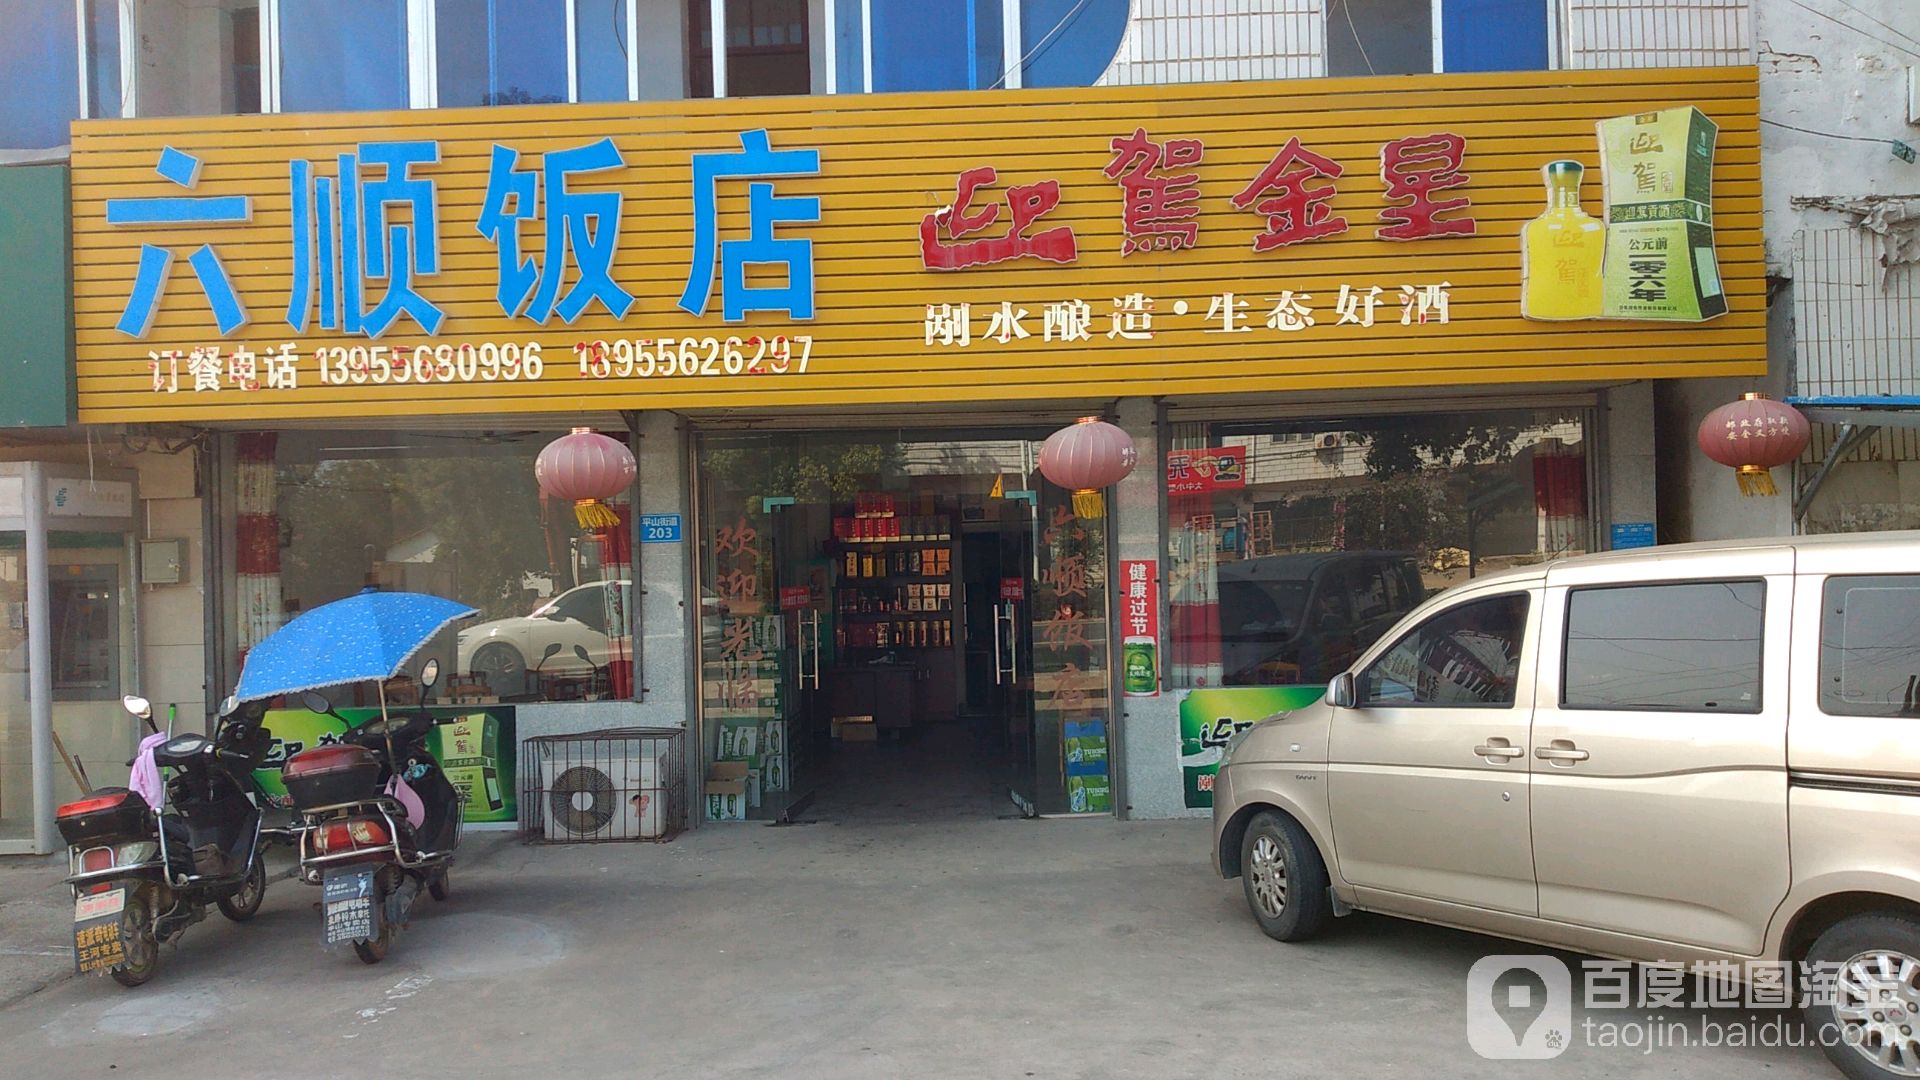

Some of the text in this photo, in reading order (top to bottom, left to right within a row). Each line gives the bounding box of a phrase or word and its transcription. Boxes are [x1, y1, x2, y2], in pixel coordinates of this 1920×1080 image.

[105, 128, 822, 339] 六顺饭店
[1628, 237, 1668, 251] 公元前
[1628, 253, 1667, 302] 一零六年
[148, 335, 813, 393] 订餐电话 13955680996 18955626297
[641, 516, 678, 527] 平山街道
[648, 527, 673, 539] 203
[715, 515, 764, 712] 欢迎光临
[1039, 504, 1093, 709] 六顺饭店
[1129, 563, 1149, 636] 健康过节
